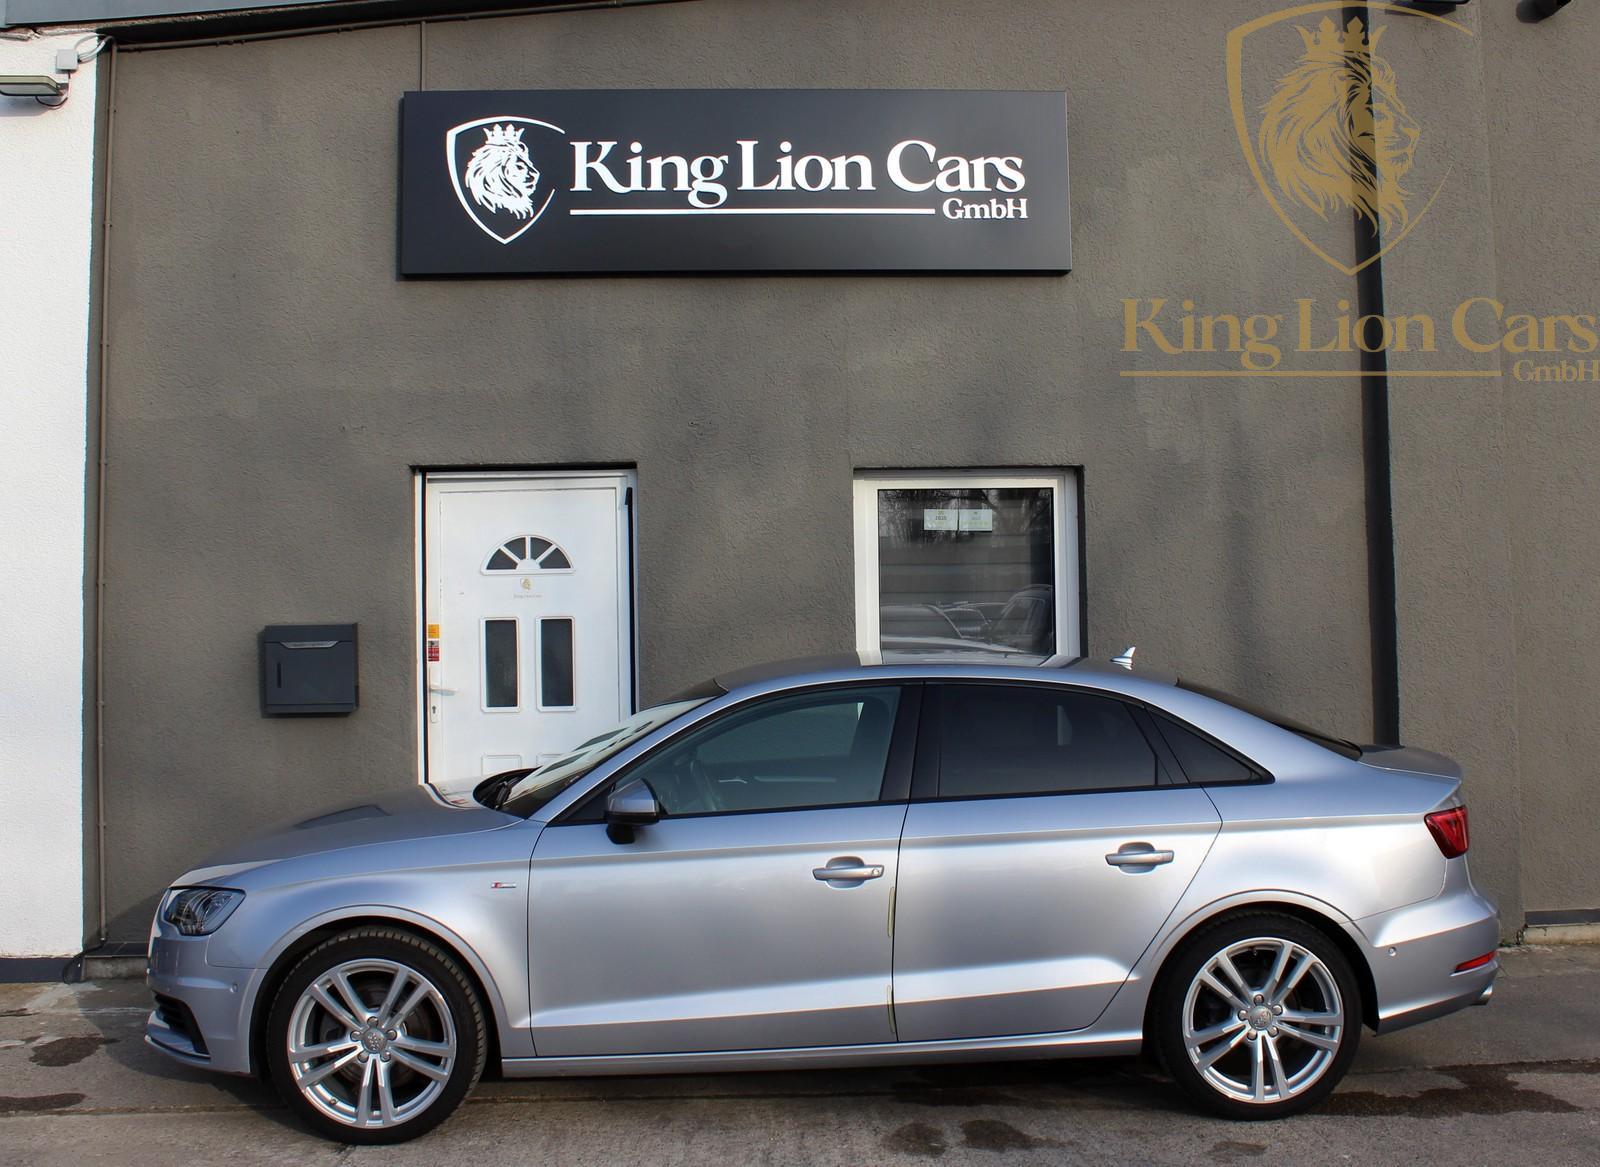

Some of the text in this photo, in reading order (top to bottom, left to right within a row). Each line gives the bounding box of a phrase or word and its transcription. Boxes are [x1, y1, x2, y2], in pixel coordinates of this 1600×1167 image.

[569, 139, 1026, 209] King Lion Cars
[942, 197, 1029, 220] GmbH
